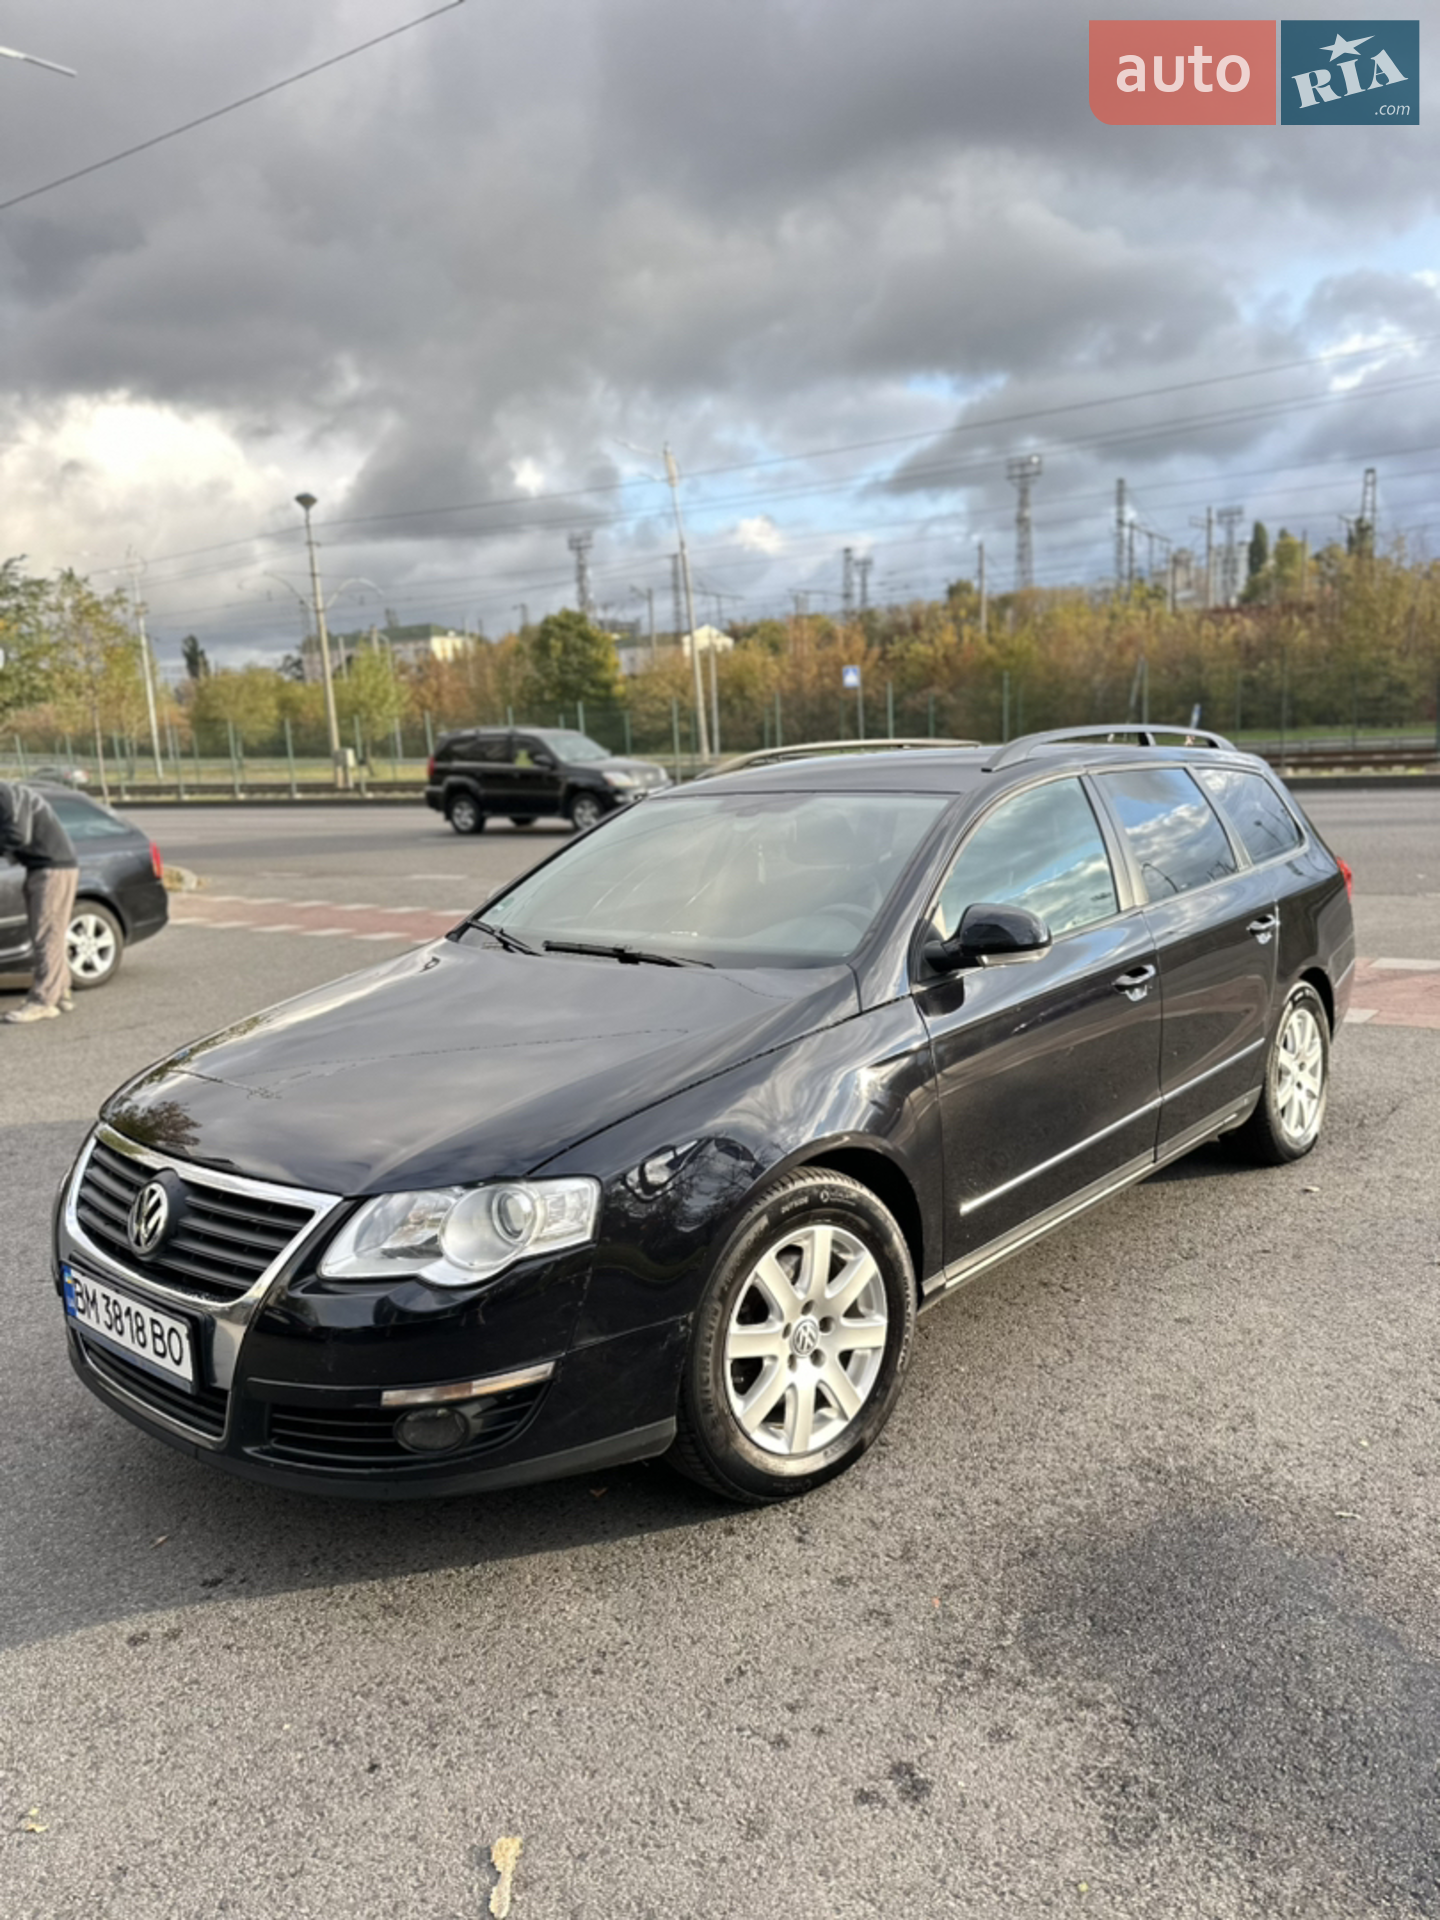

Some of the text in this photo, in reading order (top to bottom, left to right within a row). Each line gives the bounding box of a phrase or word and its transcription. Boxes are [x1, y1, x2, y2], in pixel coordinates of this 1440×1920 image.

[74, 1277, 183, 1367] BM 3818 BO
